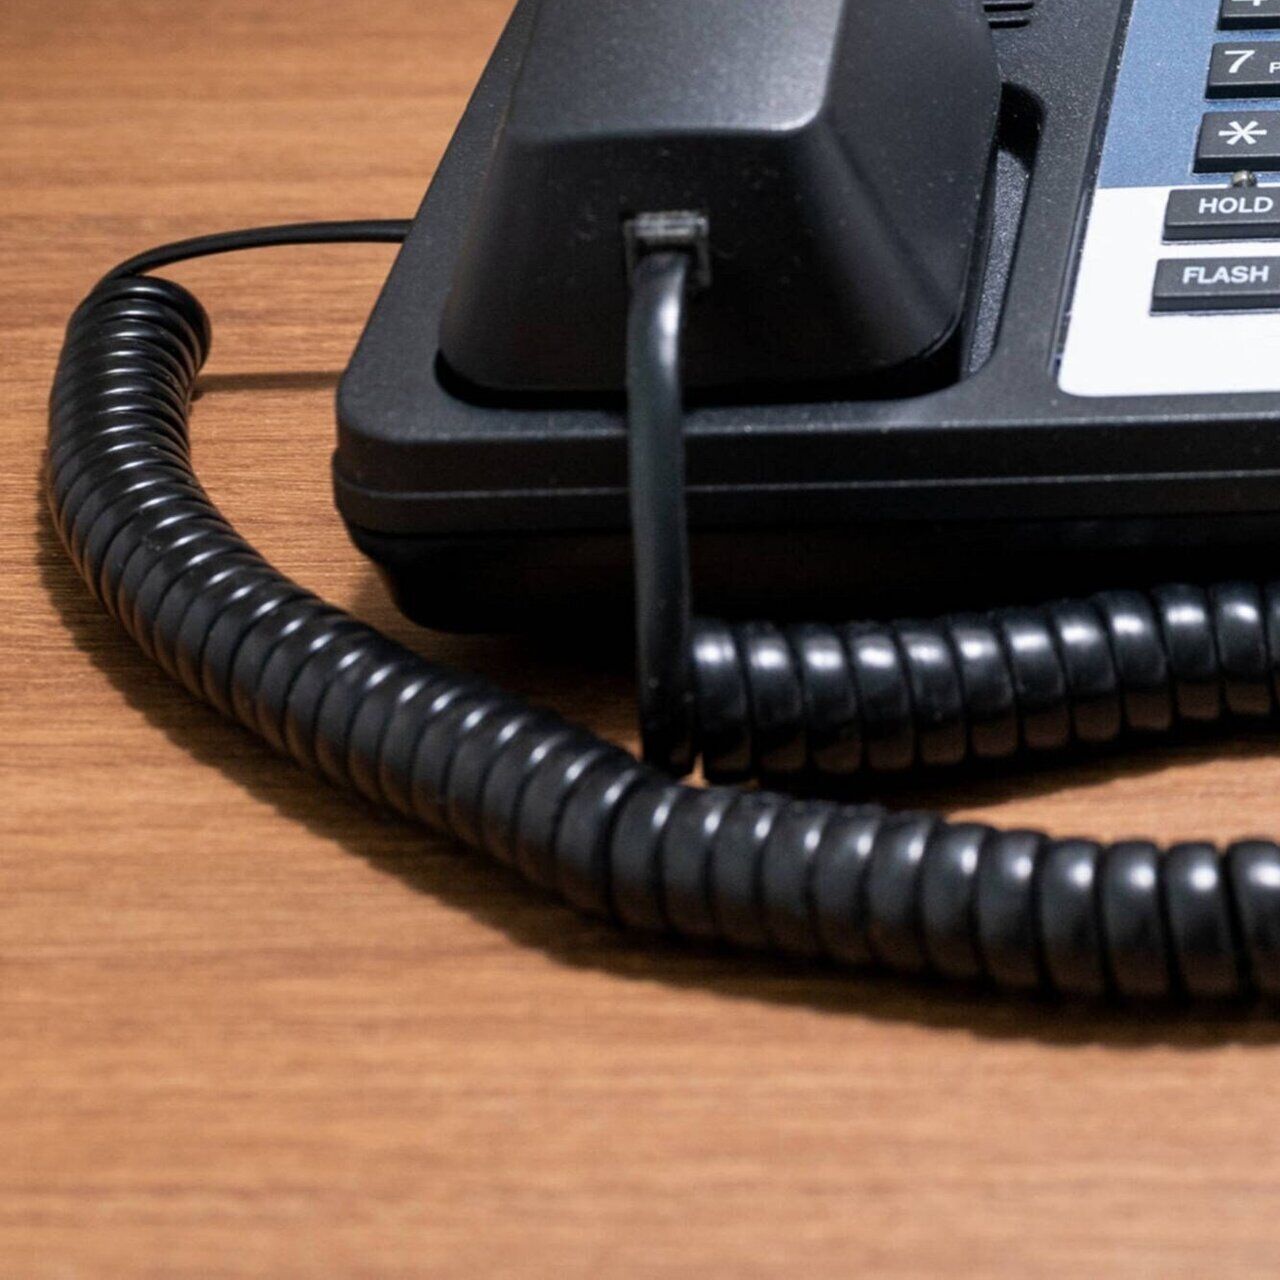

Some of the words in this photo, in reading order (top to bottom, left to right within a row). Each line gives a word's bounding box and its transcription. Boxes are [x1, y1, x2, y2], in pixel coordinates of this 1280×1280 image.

[1224, 49, 1256, 74] 7
[1198, 196, 1274, 214] HOLD
[1182, 265, 1270, 284] FLASH
